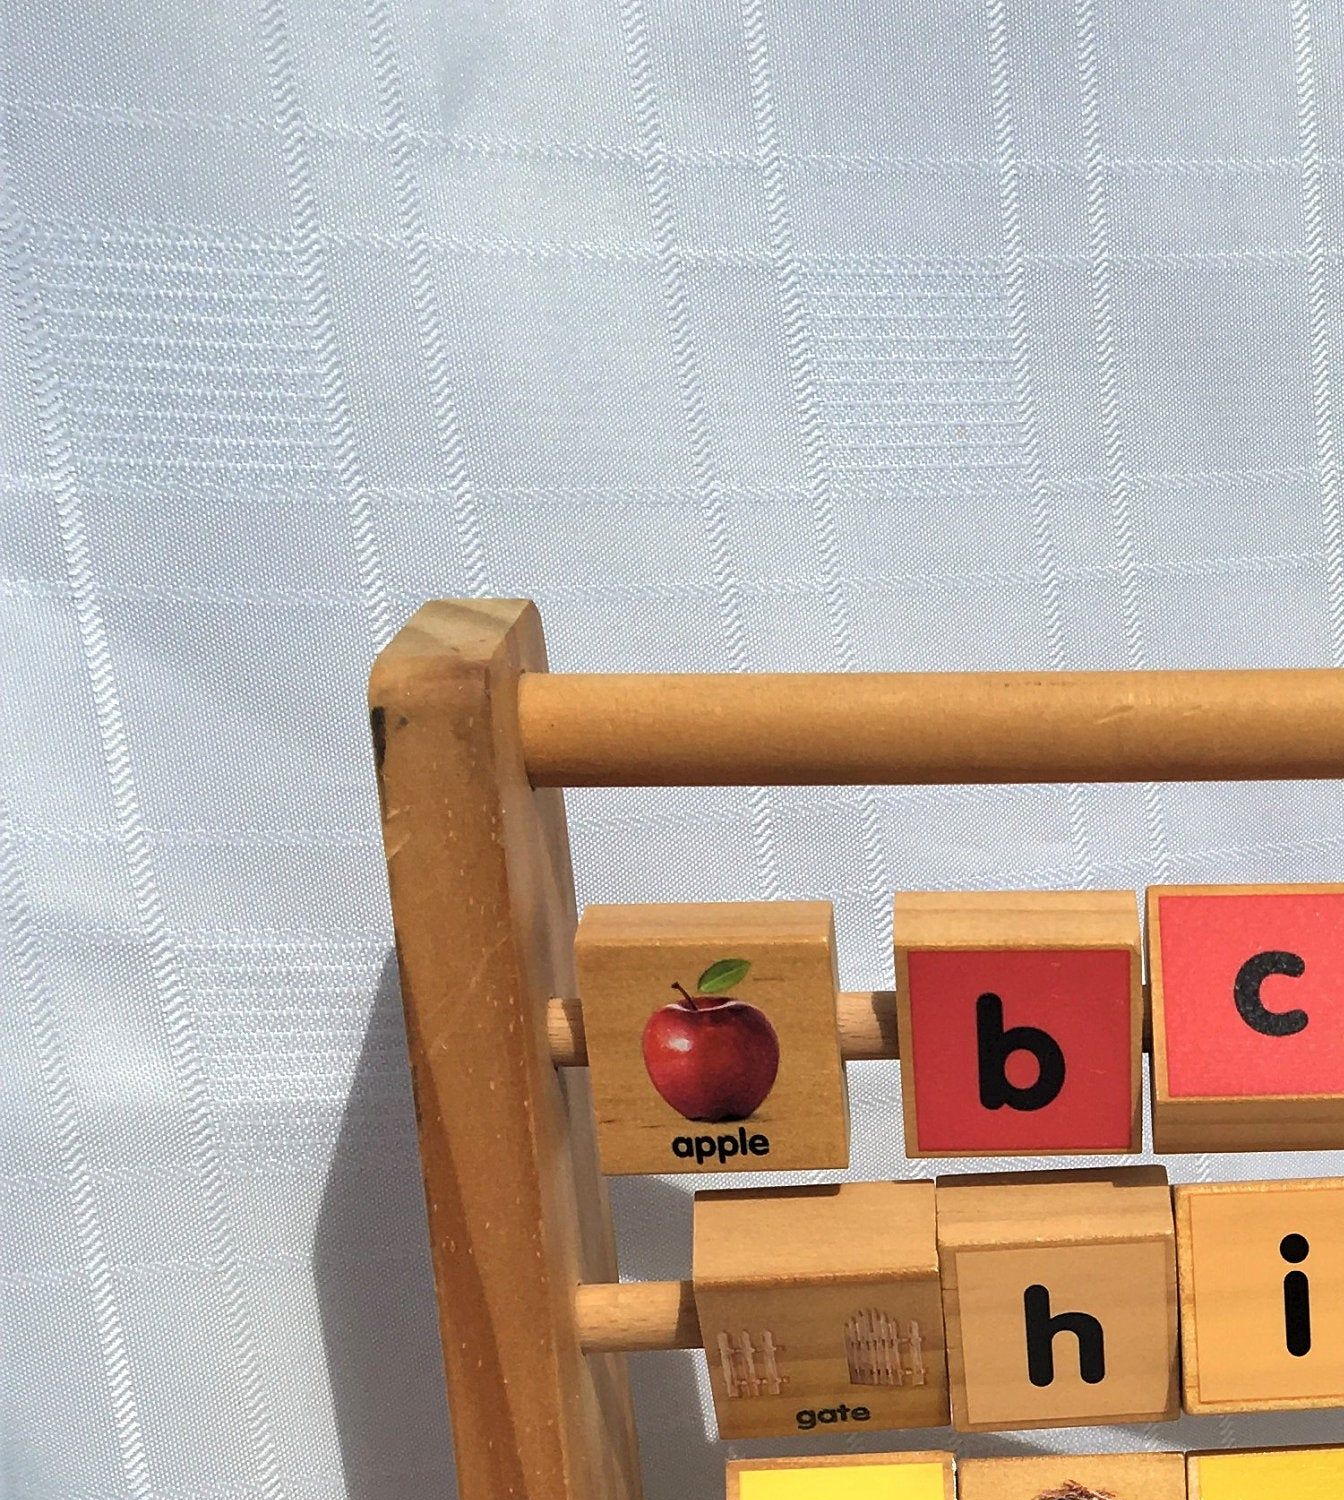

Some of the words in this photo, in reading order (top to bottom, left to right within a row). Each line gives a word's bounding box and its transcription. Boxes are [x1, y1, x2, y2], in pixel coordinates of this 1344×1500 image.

[1233, 950, 1310, 1037] c
[976, 992, 1066, 1111] b
[671, 1127, 770, 1164] apple
[1024, 1284, 1105, 1387] h
[1279, 1233, 1312, 1357] i
[796, 1402, 871, 1429] gate
